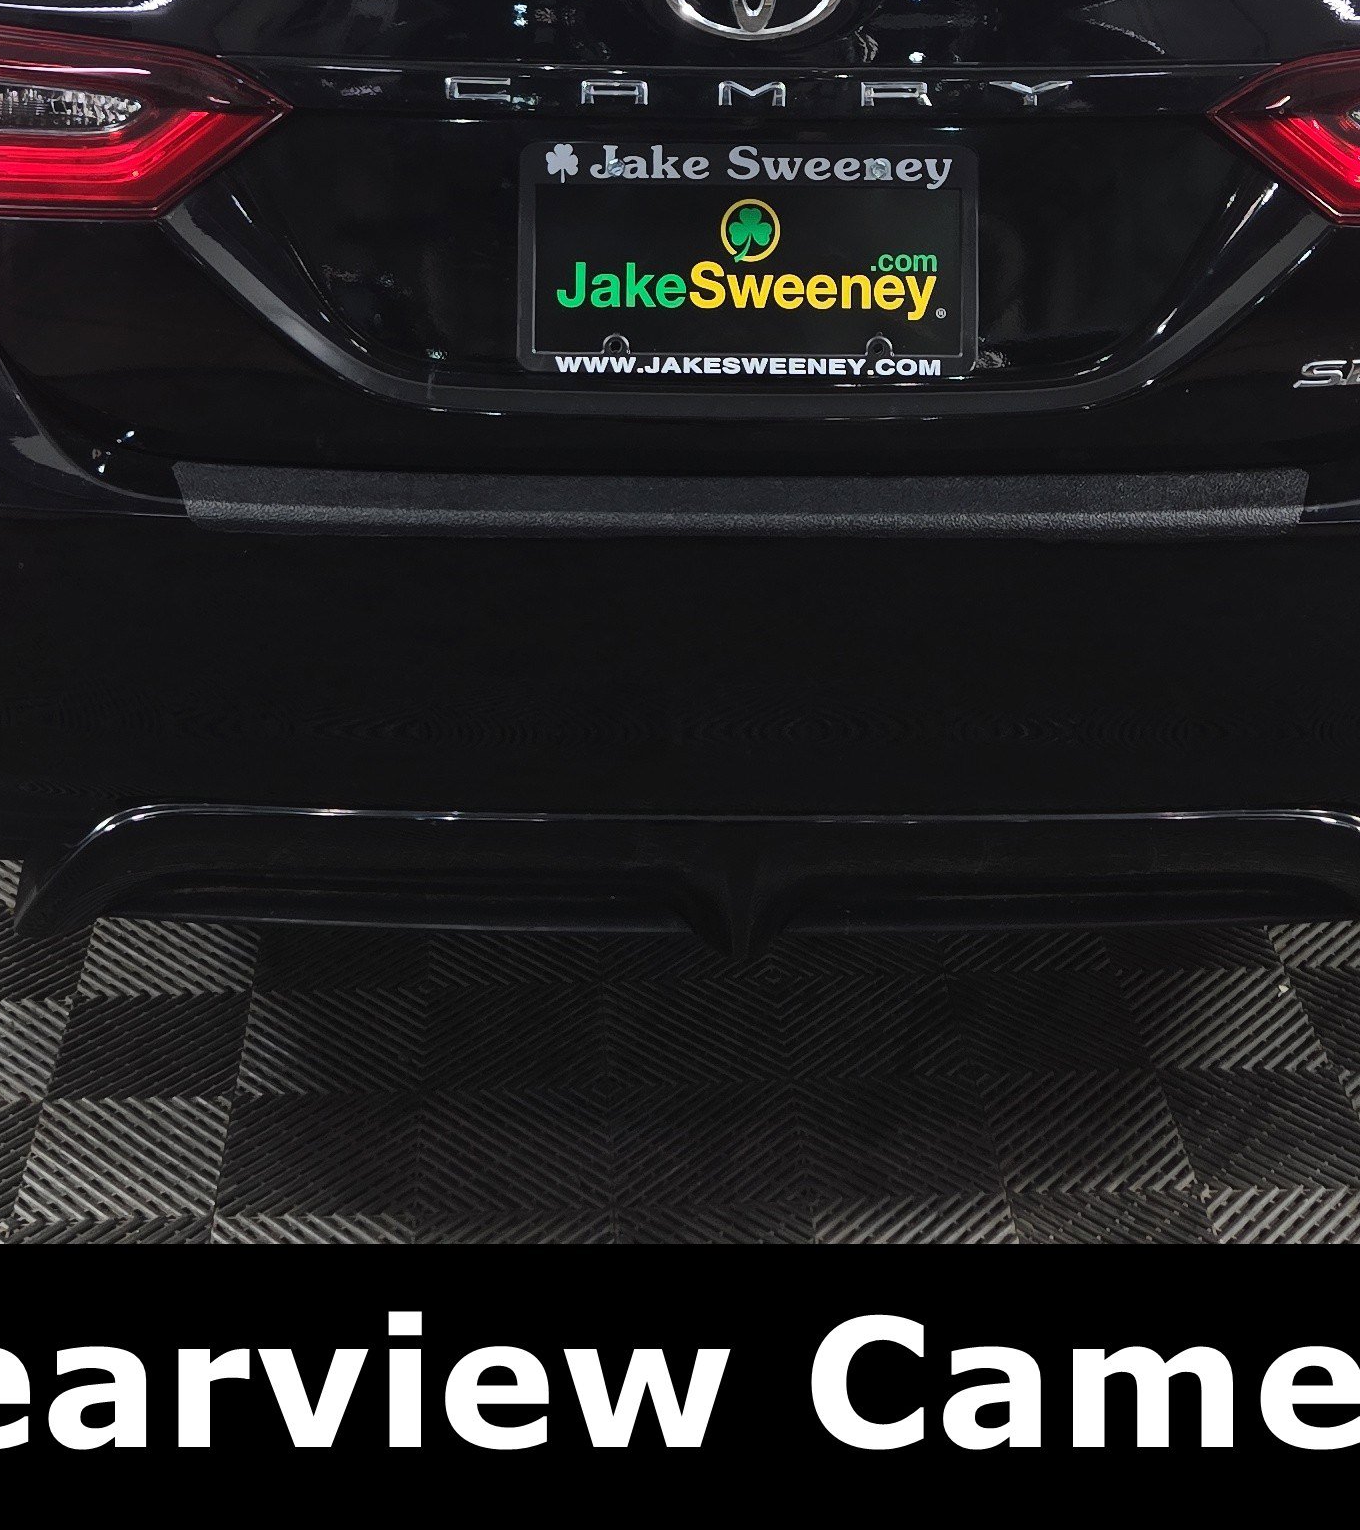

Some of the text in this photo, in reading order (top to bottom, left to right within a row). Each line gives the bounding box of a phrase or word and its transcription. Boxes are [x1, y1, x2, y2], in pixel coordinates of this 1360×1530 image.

[444, 75, 1074, 108] CAMRY
[590, 144, 953, 190] Jake Sweeney
[870, 252, 938, 273] .com
[555, 356, 942, 377] WWW.JAKESWEENEY.COM
